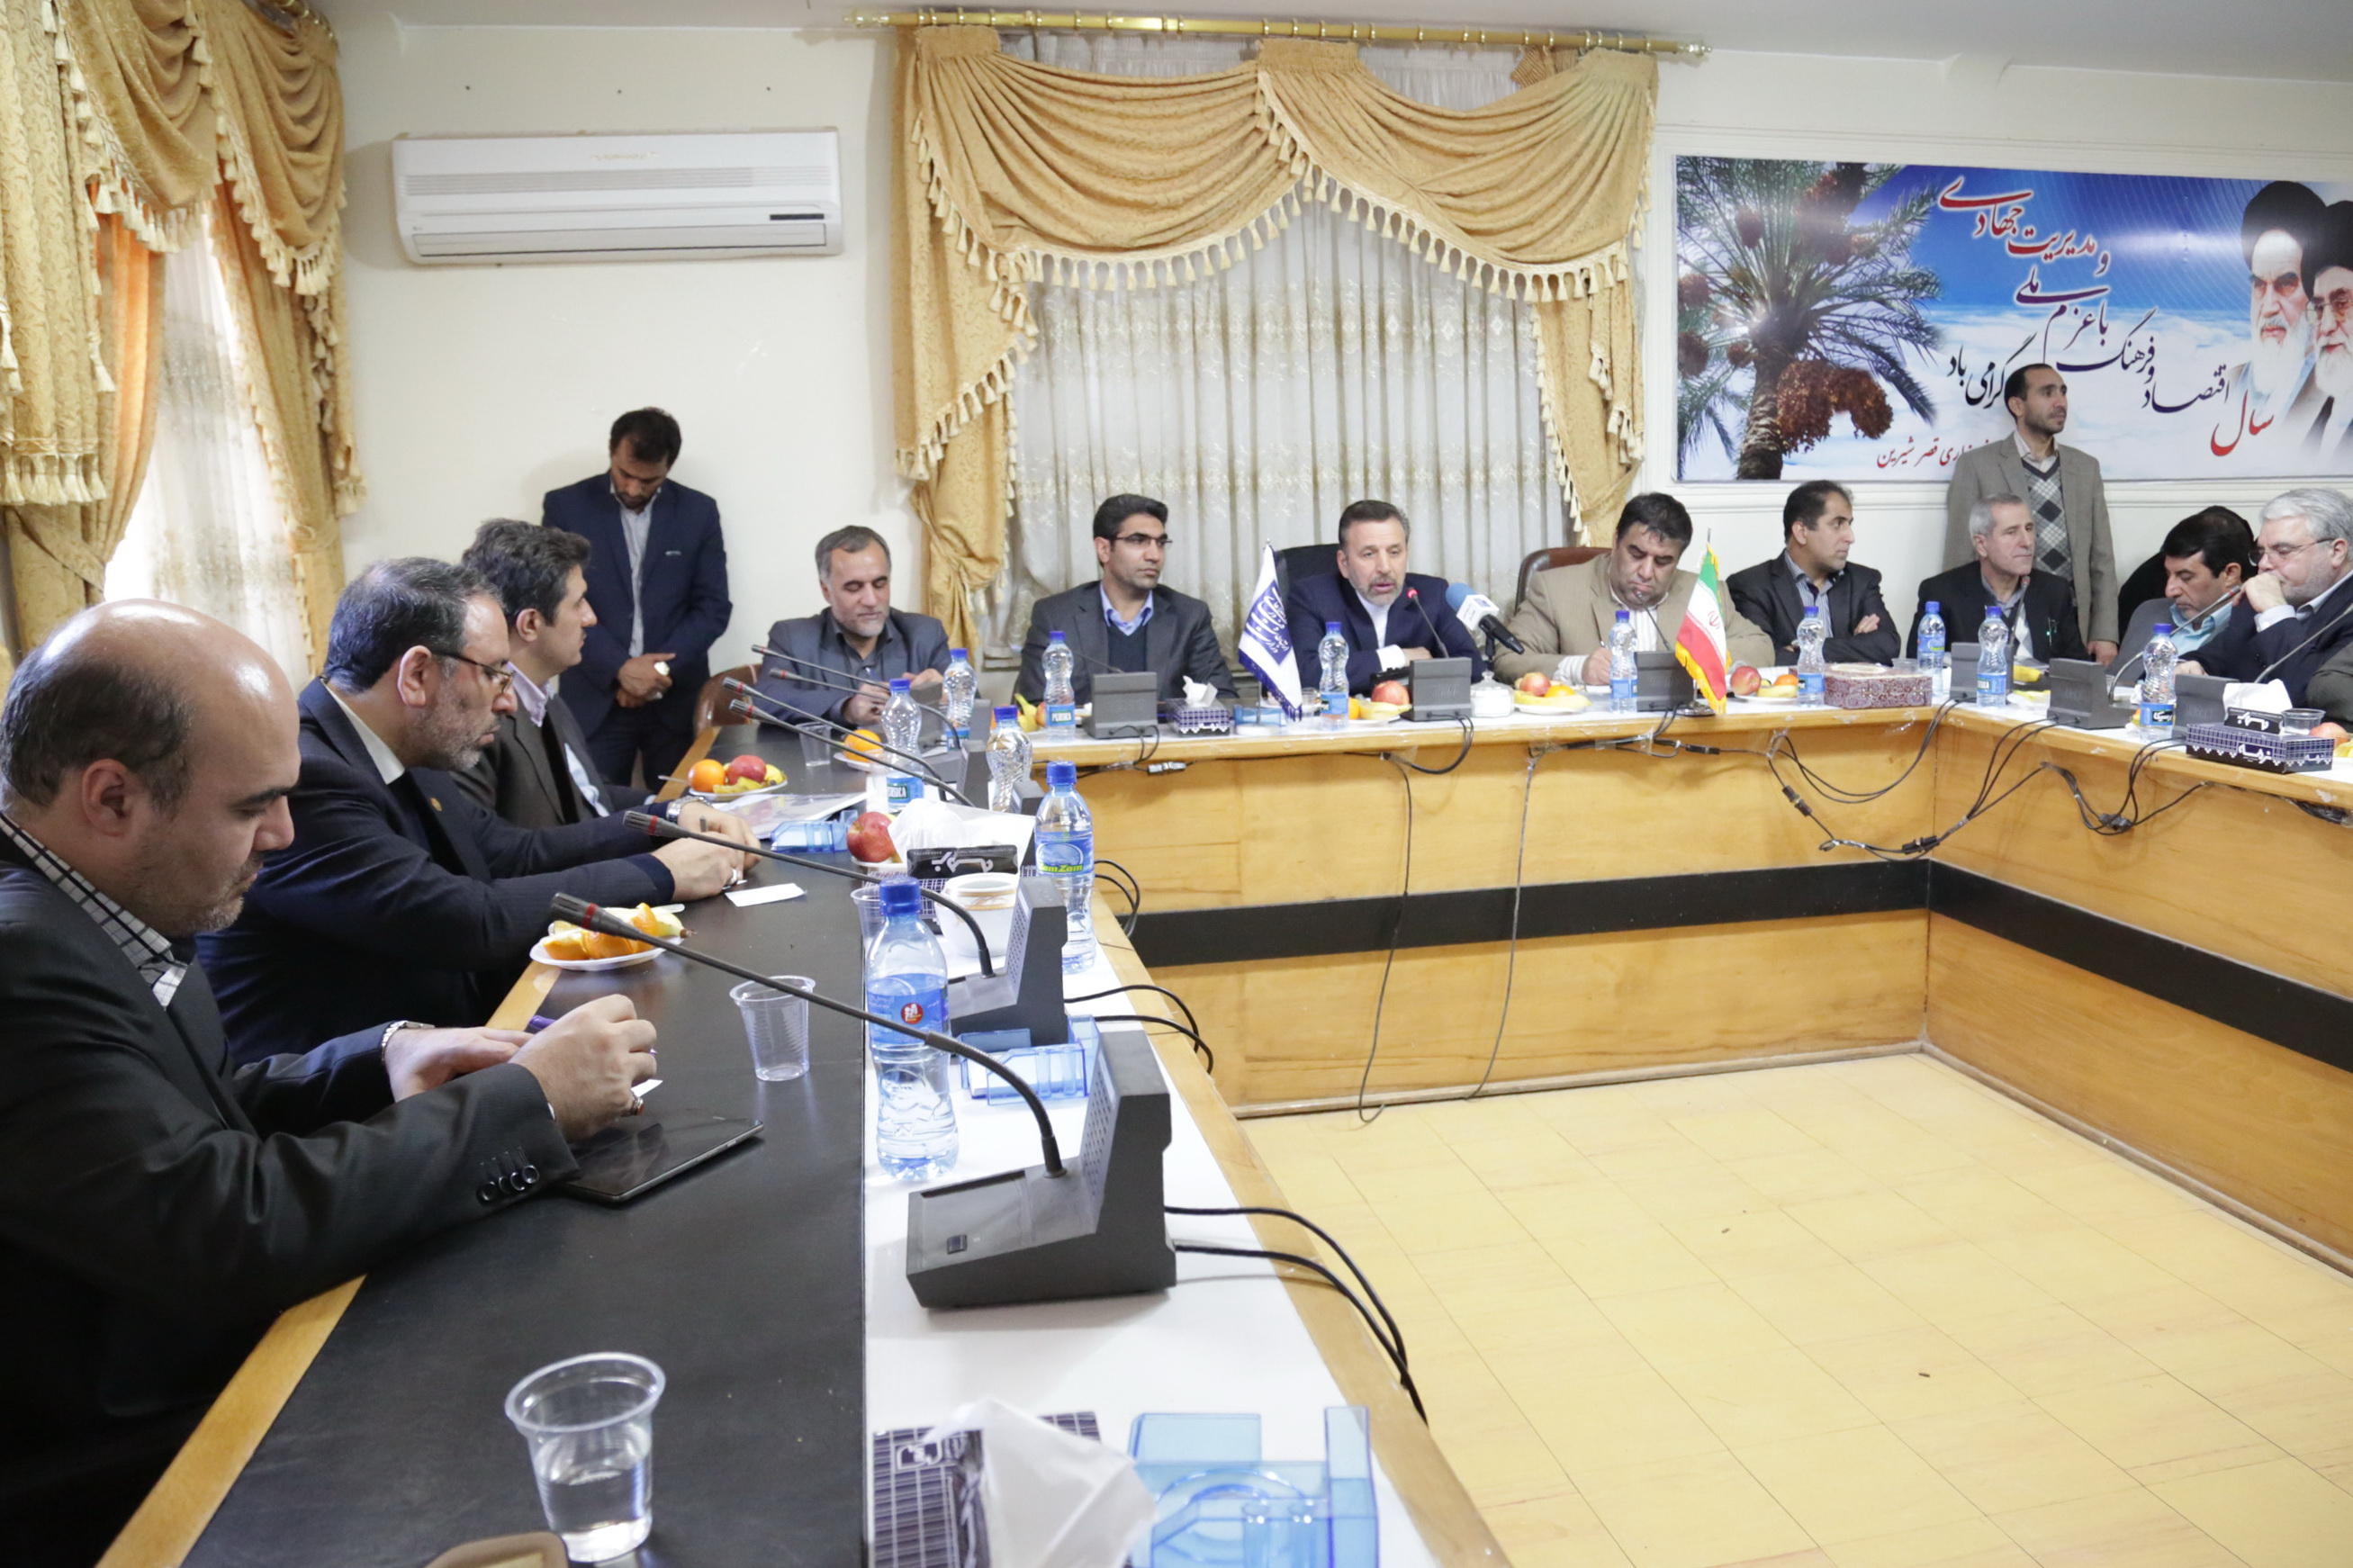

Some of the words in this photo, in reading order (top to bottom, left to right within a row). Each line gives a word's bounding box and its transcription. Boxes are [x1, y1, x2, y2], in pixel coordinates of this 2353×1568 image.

[1939, 178, 2032, 238] جهادی
[2007, 228, 2095, 260] مدیریت
[2015, 266, 2109, 304] ملی
[2042, 304, 2096, 364] عزم
[2056, 307, 2158, 374] فرهنگ
[1946, 343, 1967, 387] باد
[1965, 331, 2037, 410] گرامی
[2141, 364, 2230, 413] اقتصاد
[2211, 390, 2274, 456] سال
[1877, 436, 1915, 468] شیرین
[2238, 743, 2272, 764] نرمه
[931, 852, 994, 873] نرمه
